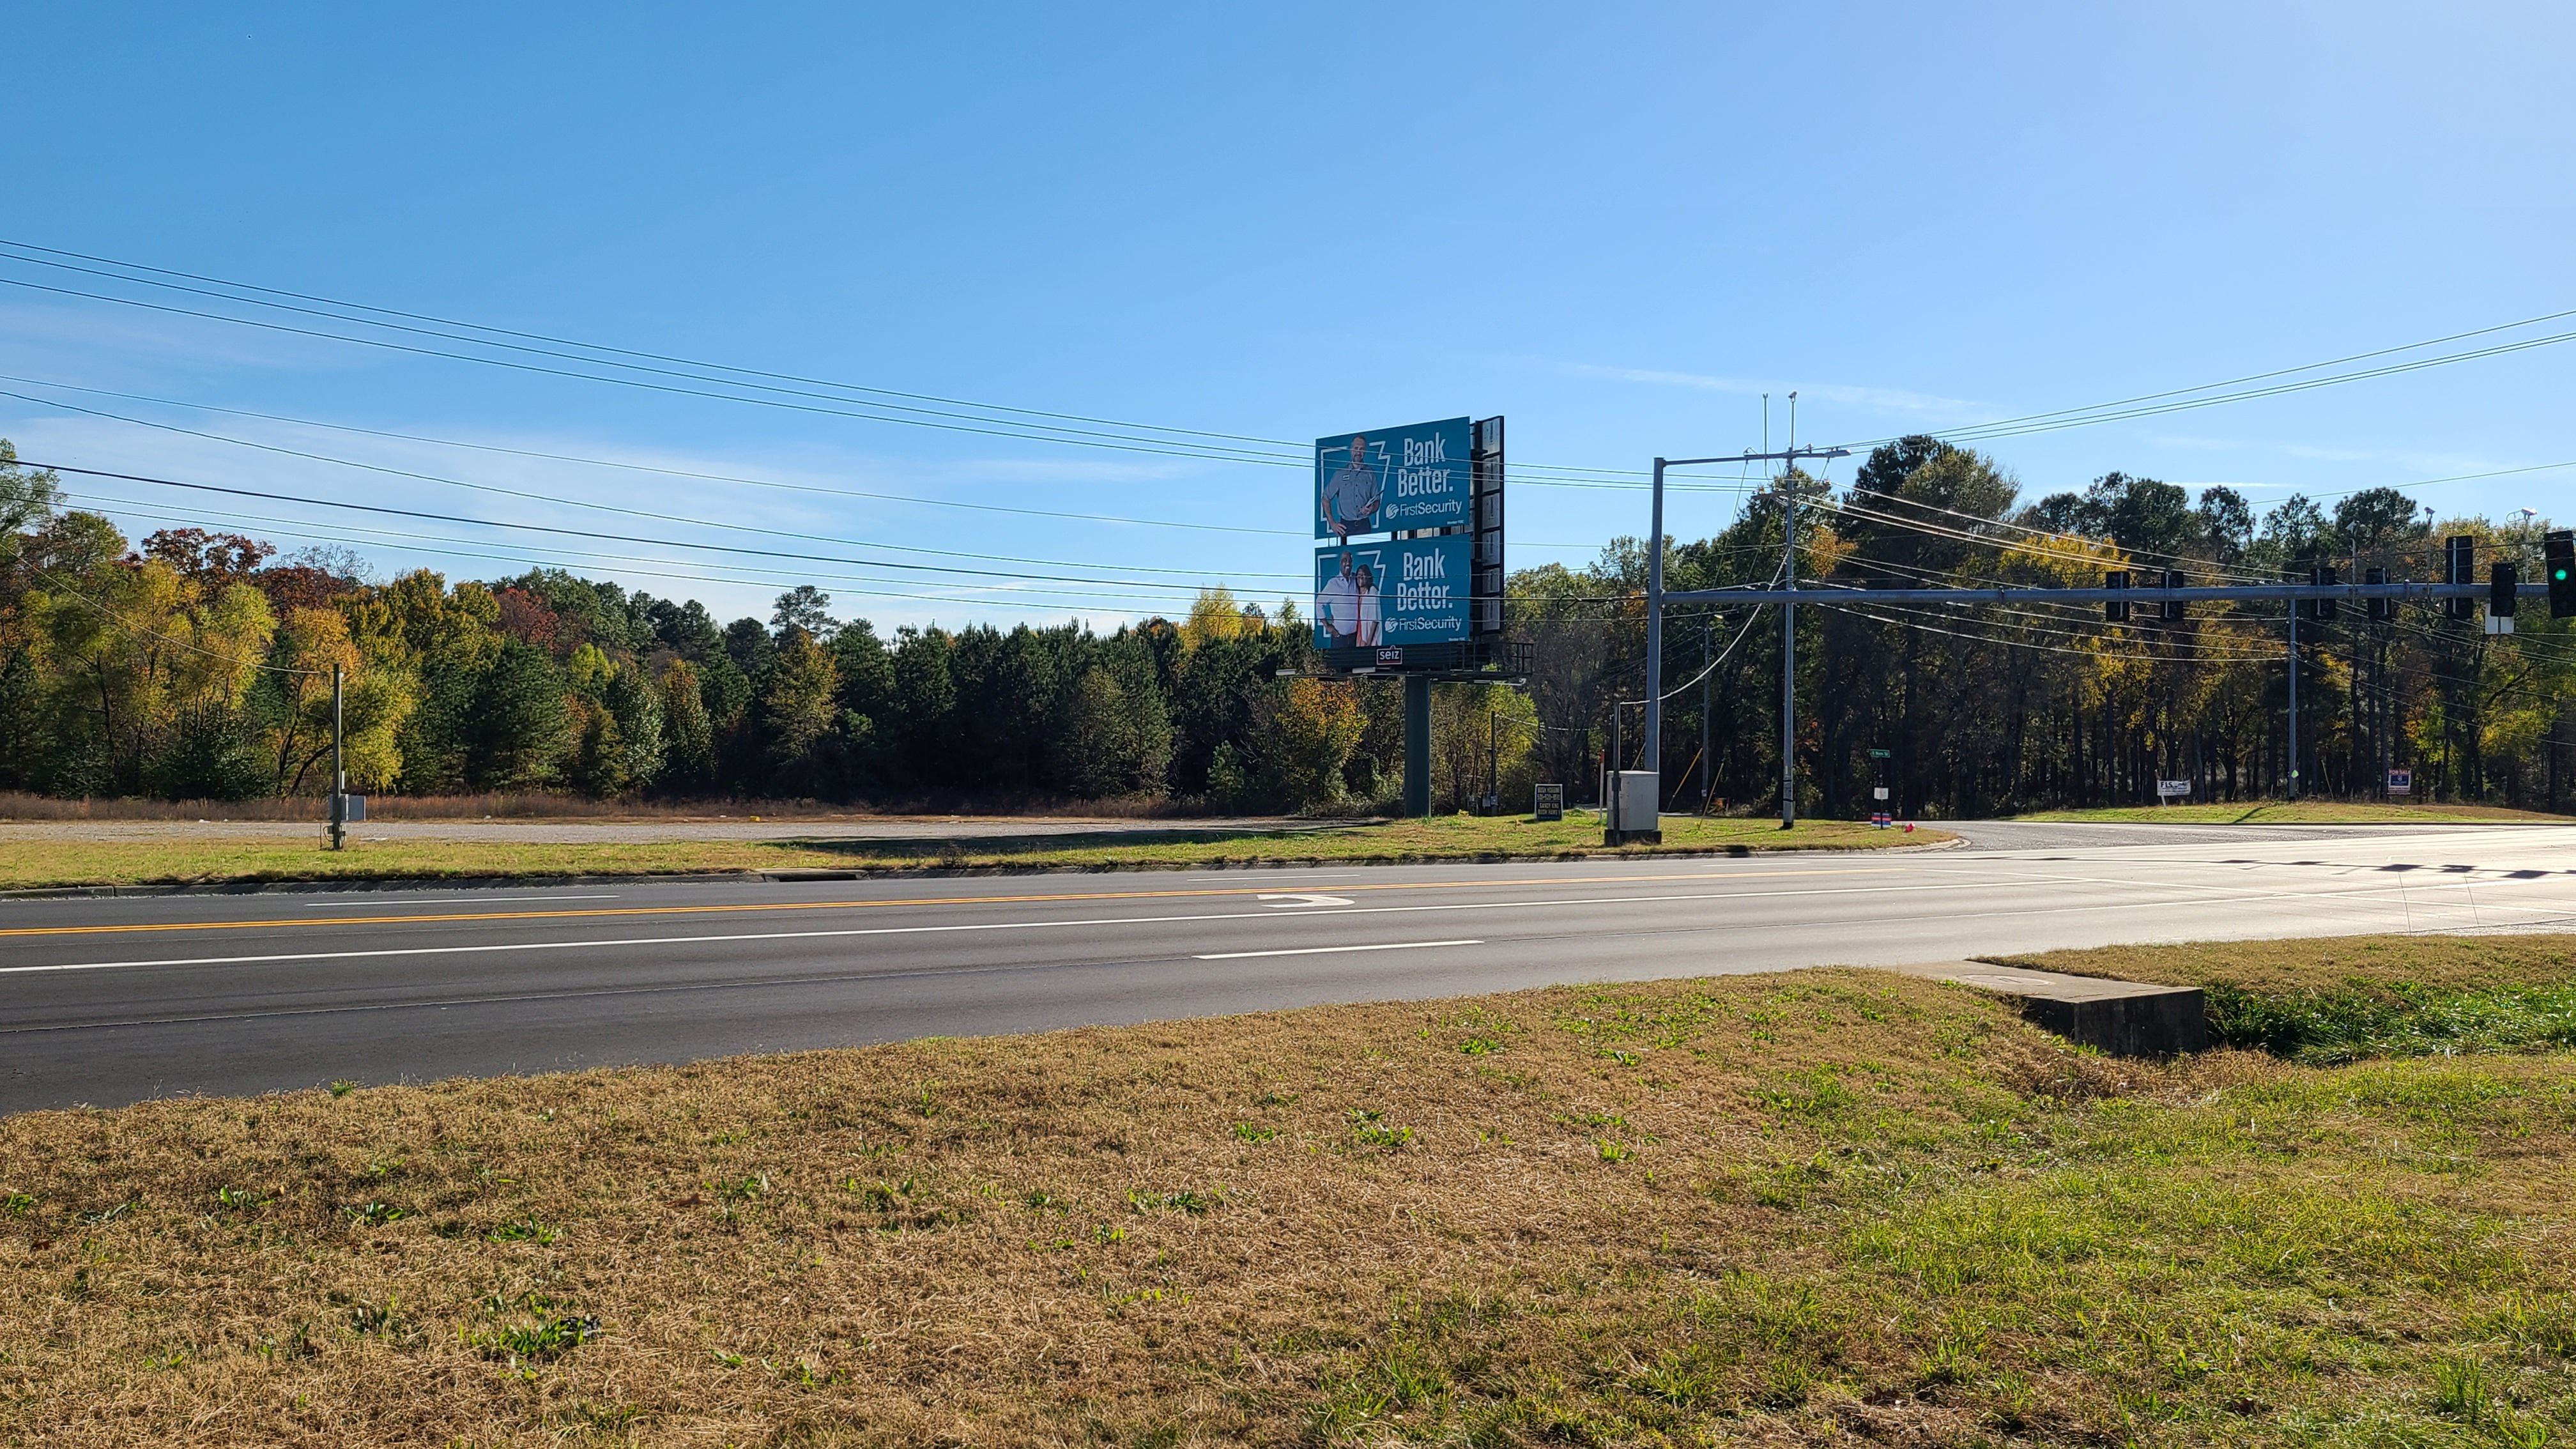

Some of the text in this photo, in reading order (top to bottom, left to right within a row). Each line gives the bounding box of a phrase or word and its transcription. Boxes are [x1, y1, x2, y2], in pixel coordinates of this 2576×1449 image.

[1404, 432, 1446, 466] Bank
[1398, 466, 1453, 497] Better.
[1400, 499, 1462, 517] FirstSecurity
[1403, 548, 1445, 581] Bank
[1397, 581, 1453, 611] Better.
[1399, 615, 1462, 631] FirstSecurity
